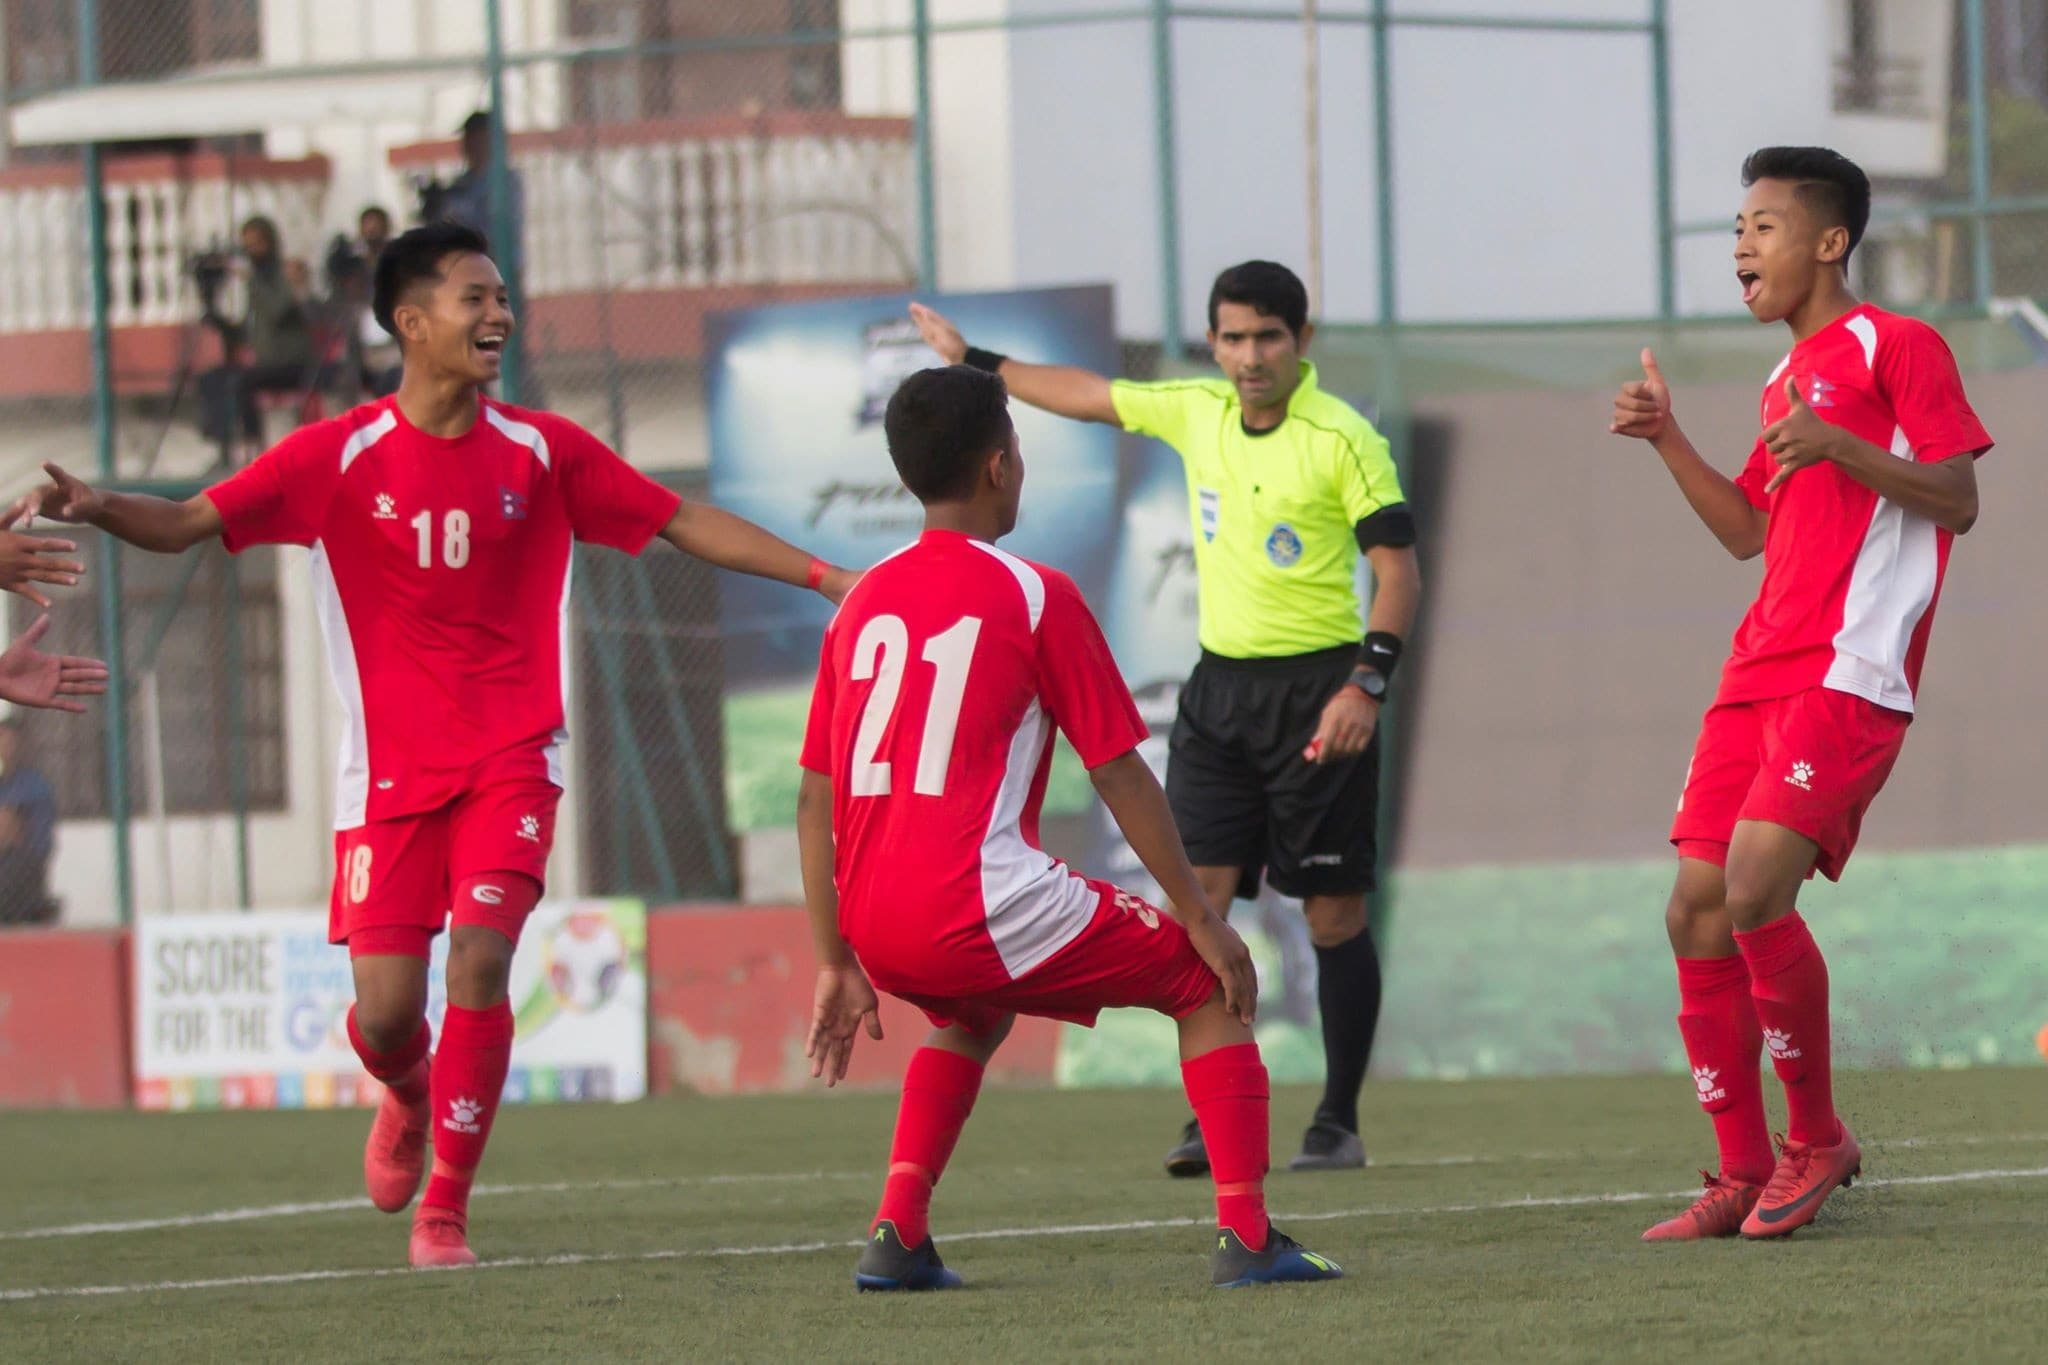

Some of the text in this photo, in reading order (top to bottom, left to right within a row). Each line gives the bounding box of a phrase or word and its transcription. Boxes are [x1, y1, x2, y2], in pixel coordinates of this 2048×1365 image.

[411, 508, 471, 569] 18
[850, 614, 982, 797] 21
[155, 934, 277, 996] SCORE
[155, 1007, 210, 1055] FOR
[219, 1004, 273, 1054] THE
